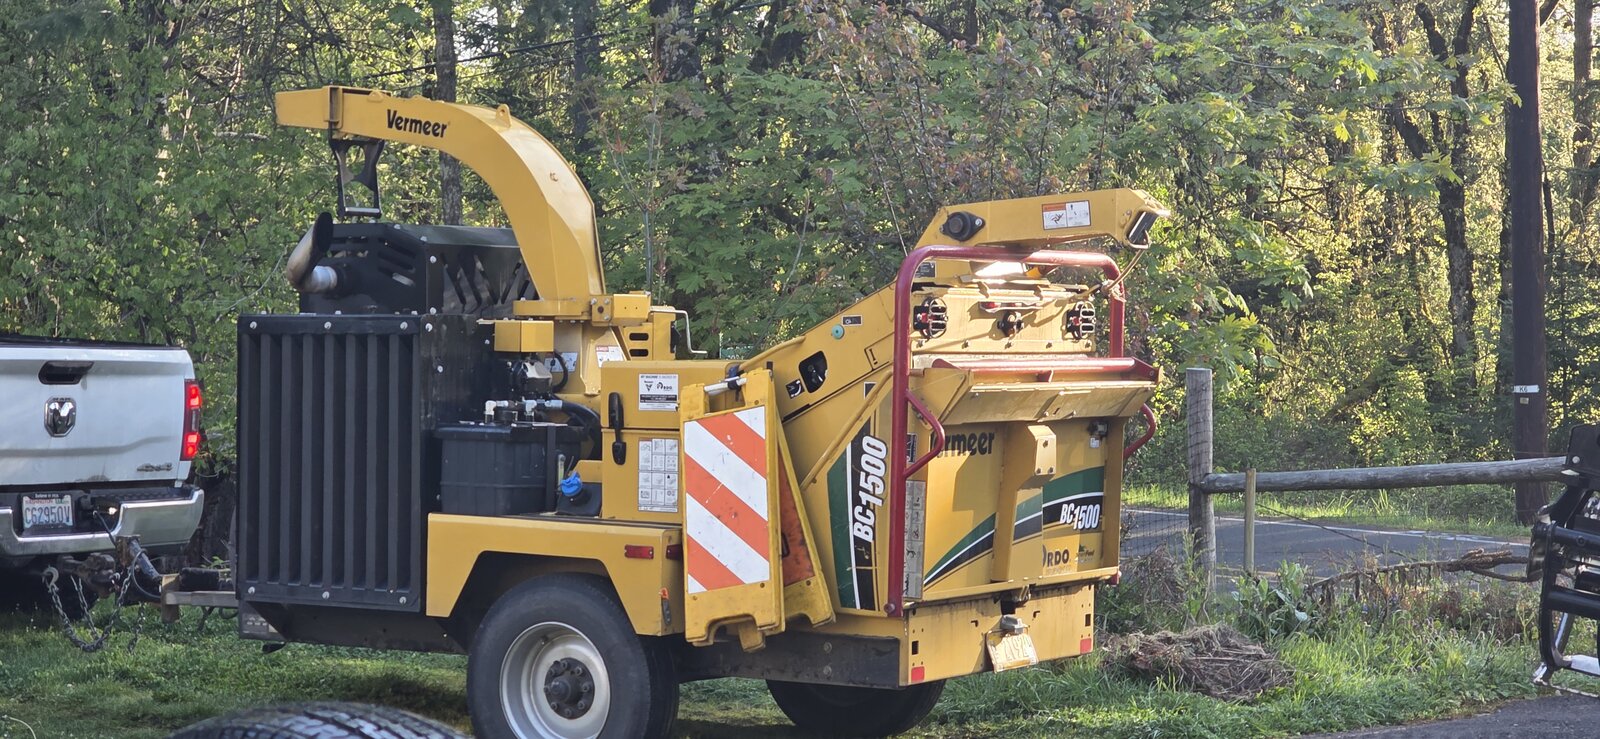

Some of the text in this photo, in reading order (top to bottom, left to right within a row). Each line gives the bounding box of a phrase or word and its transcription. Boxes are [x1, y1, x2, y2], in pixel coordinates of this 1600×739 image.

[387, 108, 448, 138] Vermeer
[853, 435, 887, 543] BC1500
[25, 506, 71, 525] C62950V
[1060, 503, 1101, 530] BC1500
[1047, 549, 1070, 567] RDO
